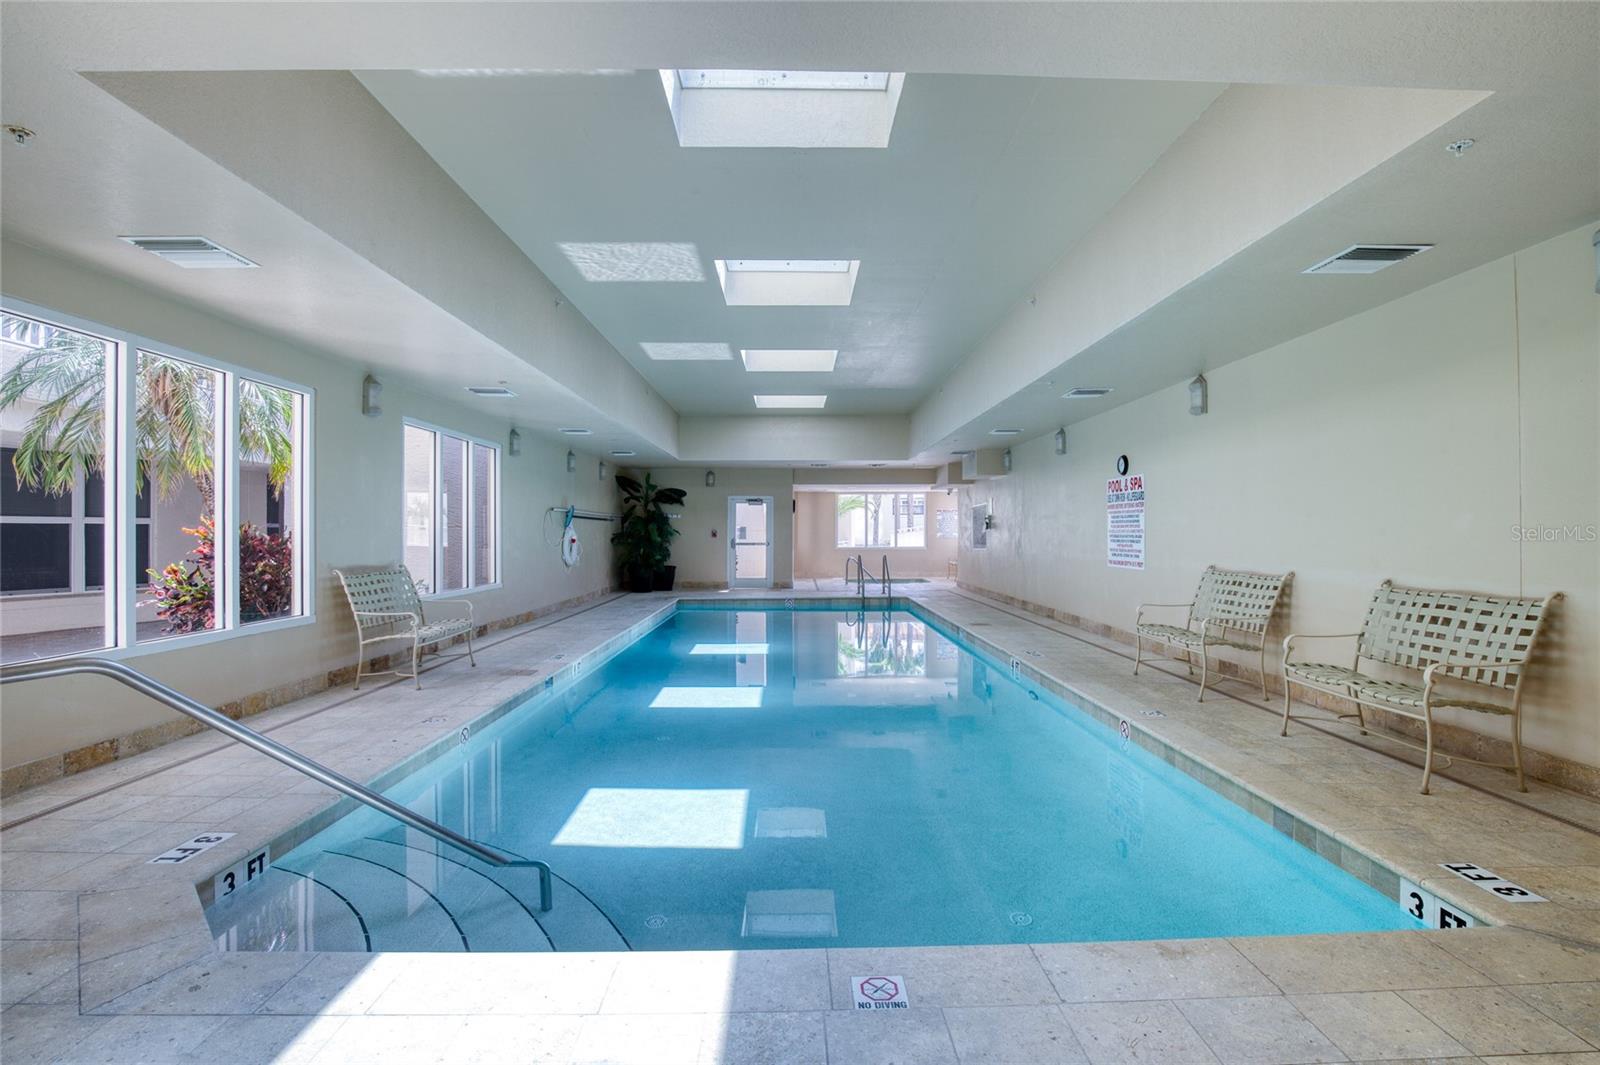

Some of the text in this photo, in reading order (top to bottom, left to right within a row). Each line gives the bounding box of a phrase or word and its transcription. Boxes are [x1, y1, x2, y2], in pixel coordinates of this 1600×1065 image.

[1108, 476, 1143, 493] POOL & SPA
[153, 848, 202, 862] FT
[223, 852, 266, 896] 3 FT
[1444, 863, 1529, 896] 3 FT
[1409, 892, 1424, 920] 3
[858, 1001, 907, 1009] NO DIVING
